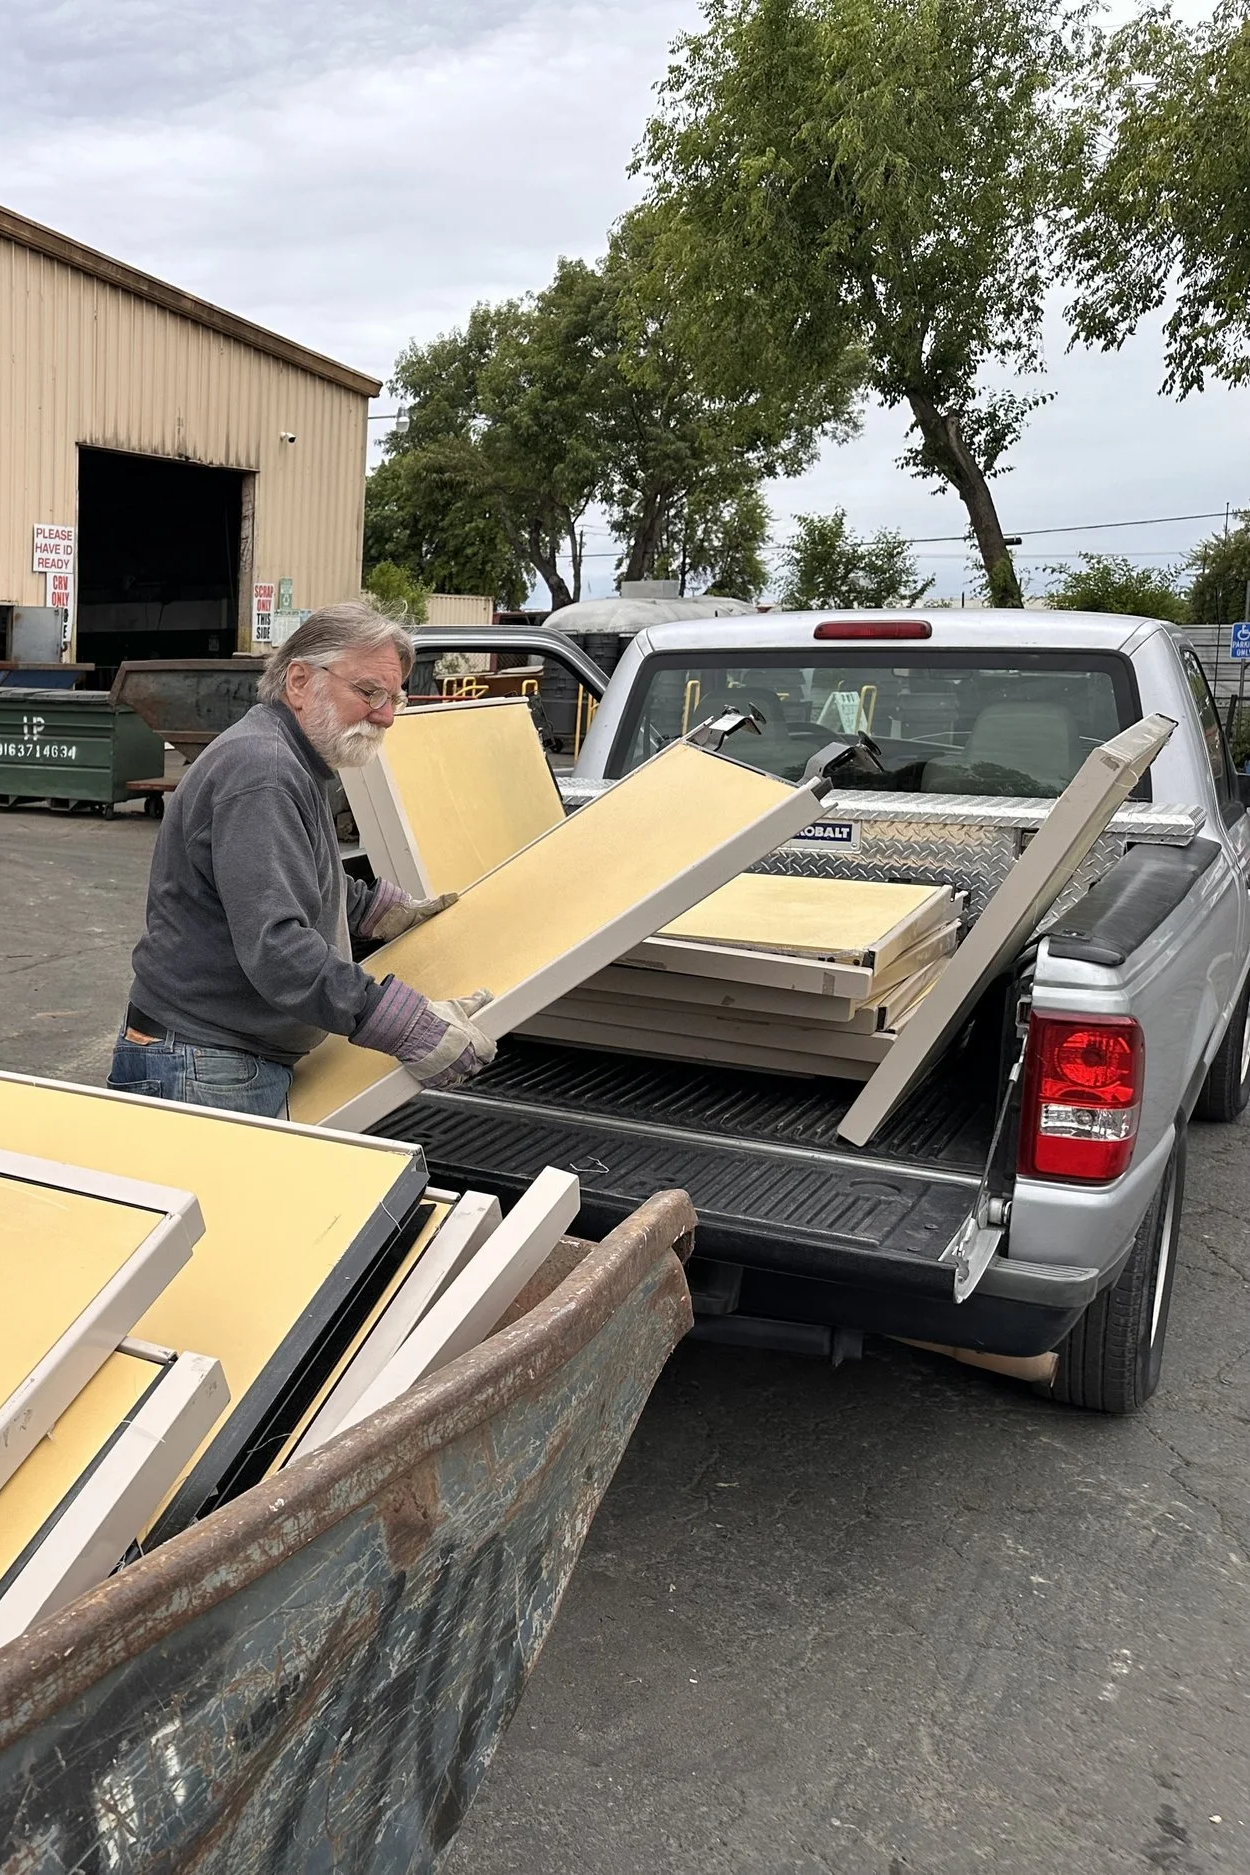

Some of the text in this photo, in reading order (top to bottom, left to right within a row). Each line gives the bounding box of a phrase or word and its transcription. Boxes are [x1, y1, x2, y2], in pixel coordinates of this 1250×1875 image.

[36, 527, 73, 541] PLEASE
[35, 542, 73, 556] HAVE ID
[37, 557, 70, 570] READY
[53, 574, 69, 591] CRV
[254, 584, 274, 599] SCRAP
[51, 591, 70, 607] ONLY
[257, 599, 272, 612] ONLY
[256, 612, 271, 626] THIS
[256, 626, 270, 640] SIDE
